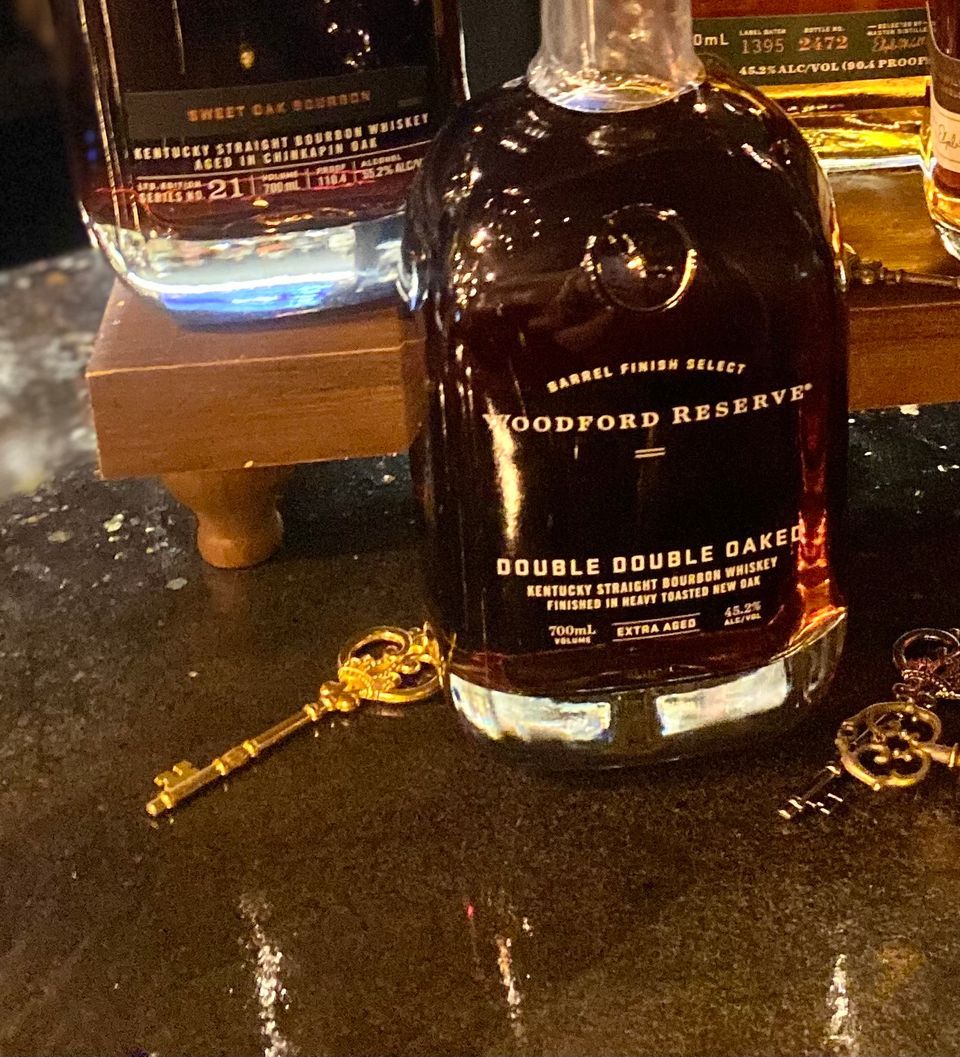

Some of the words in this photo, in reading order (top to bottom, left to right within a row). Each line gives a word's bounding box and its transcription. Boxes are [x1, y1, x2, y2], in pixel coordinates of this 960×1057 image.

[693, 33, 729, 46] 0mL
[741, 38, 785, 55] 1395
[798, 35, 848, 52] 2472
[778, 62, 839, 75] ALC/VOL
[187, 104, 245, 123] SWEET
[253, 101, 287, 117] OAK
[292, 90, 372, 112] BOURBON
[133, 145, 210, 161] KENTUCKY
[215, 136, 288, 156] STRAIGHT
[293, 126, 363, 147] BOURBON
[366, 112, 430, 136] WHISKEY
[194, 156, 233, 172] AGED
[240, 155, 256, 167] IN
[263, 143, 345, 165] CHINKAPIN
[350, 137, 379, 152] OAK
[207, 177, 245, 201] 21
[546, 365, 614, 394] BARREL
[619, 358, 680, 376] FINISH
[685, 357, 747, 376] SELECT
[482, 410, 660, 433] WOODFORD
[672, 382, 808, 426] RESERVE
[496, 557, 601, 577] DOUBLE
[612, 545, 714, 574] DOUBLE
[725, 523, 806, 558] OAKED
[526, 583, 593, 598] KENTUCKY
[596, 578, 658, 596] STRAIGHT
[662, 568, 722, 589] BOURBON
[724, 555, 779, 579] WHISKEY
[546, 598, 602, 611] FINISHED
[605, 596, 618, 609] IN
[622, 594, 657, 607] HEAVY
[661, 586, 709, 604] TOASTED
[712, 581, 738, 595] NEW
[740, 575, 761, 590] OAK
[724, 601, 762, 618] 45.2%
[724, 612, 762, 626] ALC/VOL
[548, 624, 597, 637] 700mL
[616, 621, 660, 637] EXTRA
[663, 618, 697, 632] AGED
[554, 635, 591, 645] VOLUME
